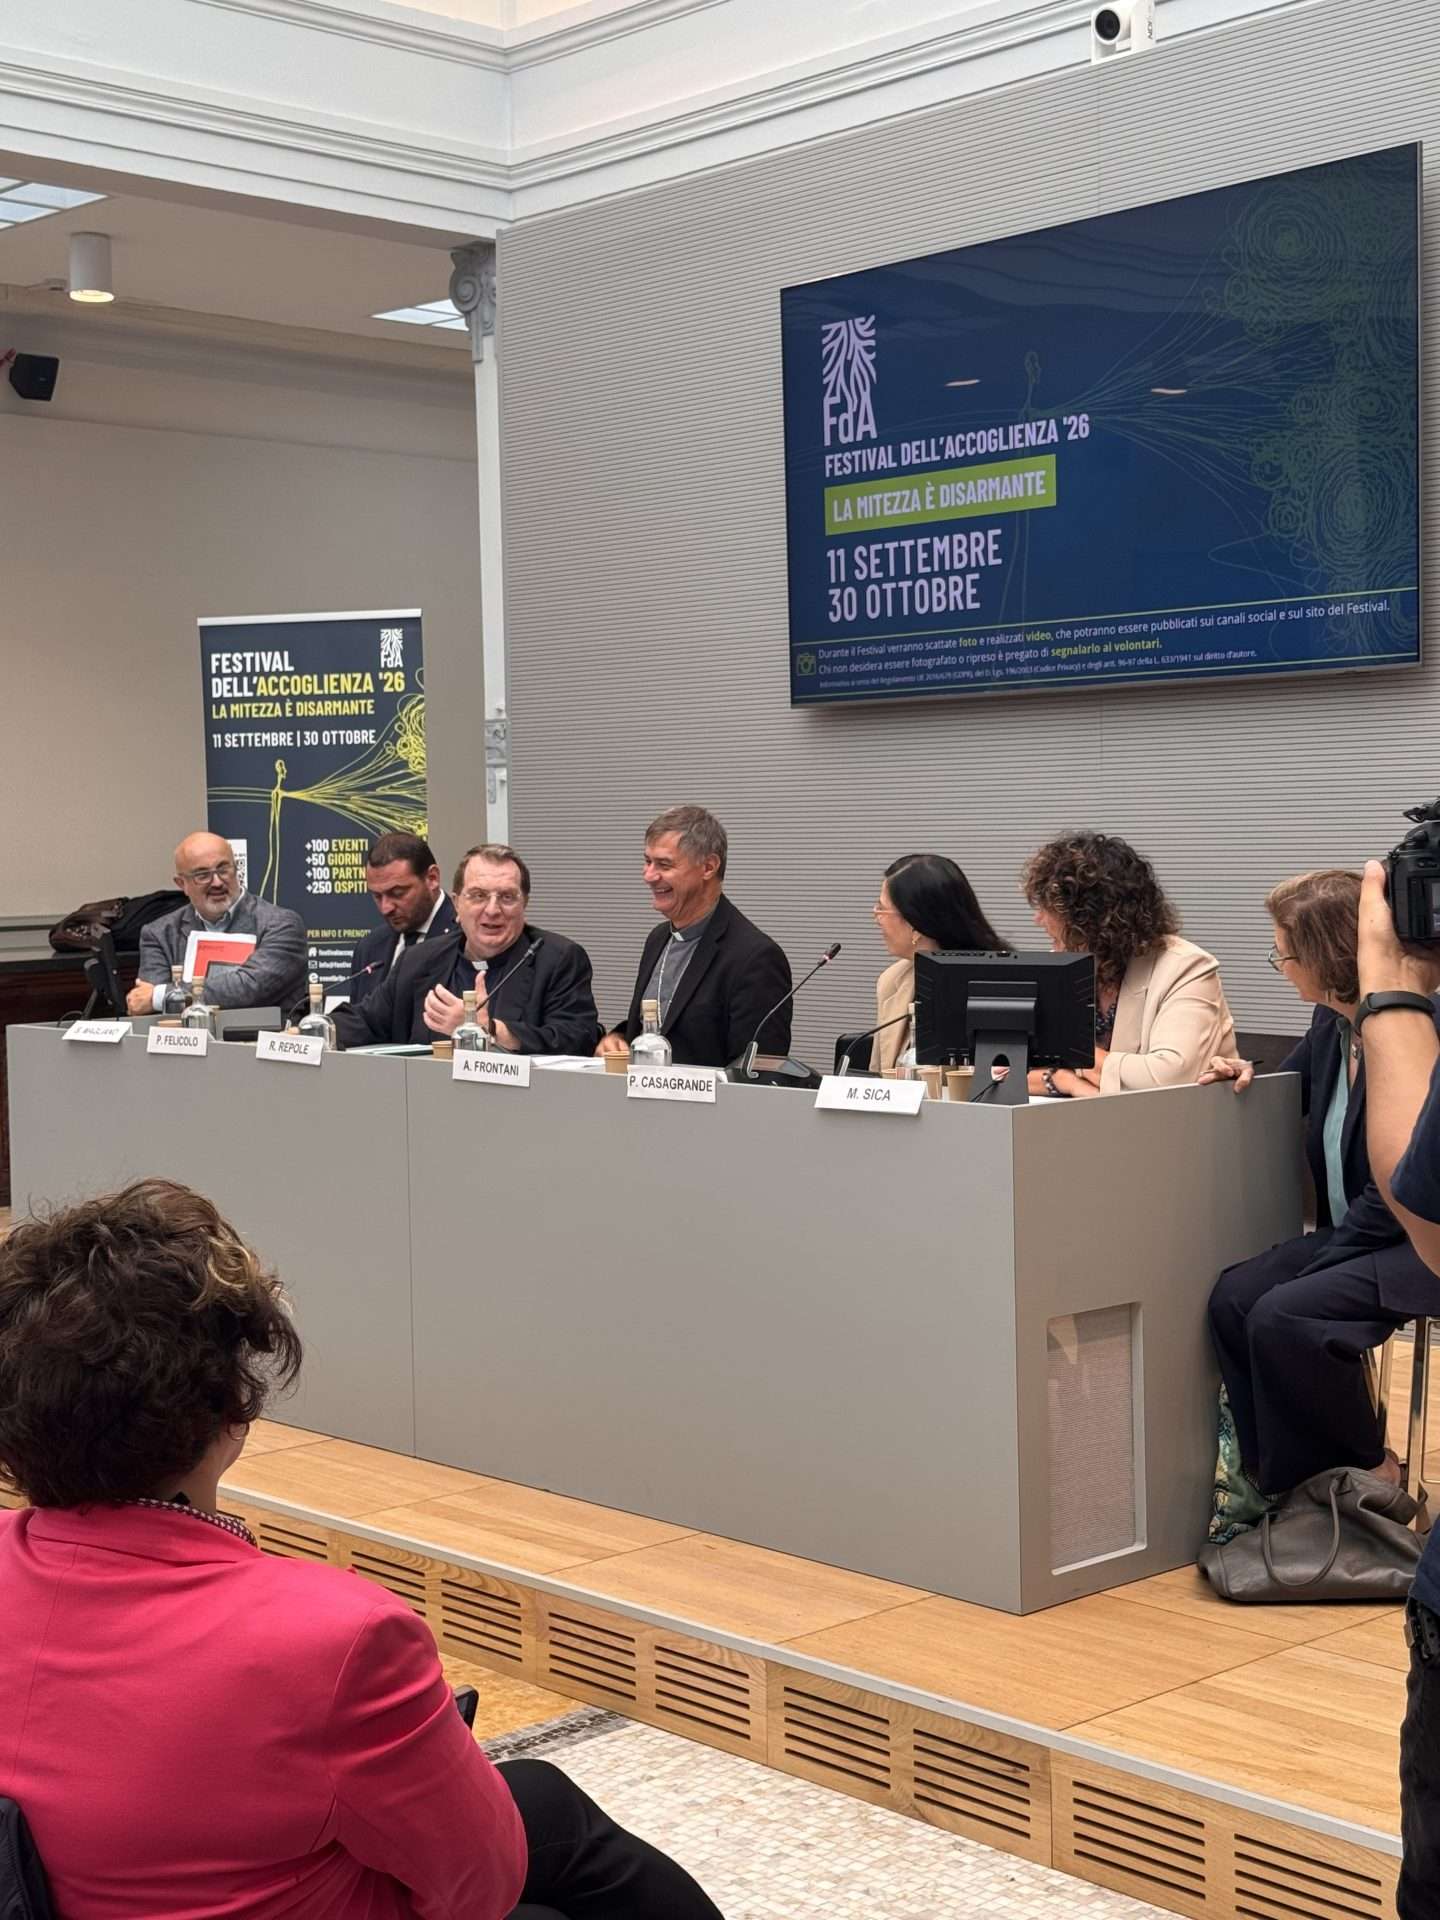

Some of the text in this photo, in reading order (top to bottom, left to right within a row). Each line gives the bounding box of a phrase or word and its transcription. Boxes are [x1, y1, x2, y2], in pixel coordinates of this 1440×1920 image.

[825, 414, 1089, 477] FESTIVAL DELL'ACCOGLIENZA '26
[834, 470, 1046, 522] LA MITEZZA È DISARMANTE
[827, 529, 1002, 584] 11 SETTEMBRE
[828, 573, 980, 623] 30 OTTOBRE
[818, 646, 848, 659] Durante
[856, 643, 885, 656] Festival
[886, 642, 923, 653] verranno
[925, 638, 957, 650] scattate
[959, 635, 976, 647] foto
[979, 637, 984, 645] e
[986, 631, 1023, 645] realizzati
[1025, 628, 1053, 642] video,
[1055, 627, 1071, 639] che
[1074, 624, 1115, 640] potranno
[1118, 622, 1148, 634] essere
[1150, 615, 1196, 634] pubblicati
[1216, 611, 1244, 625] canali
[1247, 608, 1276, 622] social
[1279, 610, 1285, 620] e
[1287, 606, 1303, 619] sul
[1305, 604, 1324, 617] sito
[1327, 602, 1343, 615] del
[1346, 598, 1389, 614] Festival.
[211, 651, 294, 674] FESTIVAL
[818, 663, 830, 674] Chi
[832, 664, 847, 673] non
[849, 659, 882, 672] desidera
[883, 659, 909, 669] essere
[911, 653, 957, 670] fotografato
[958, 655, 964, 663] o
[966, 649, 995, 665] ripreso
[1005, 648, 1038, 663] pregato
[1040, 646, 1048, 657] di
[1050, 642, 1100, 659] segnalarlo
[1114, 636, 1162, 651] volontari.
[212, 671, 405, 698] DELL'ACCOGLIENZA '26
[212, 698, 375, 719] LA MITEZZA È DISARMANTE
[213, 734, 221, 748] 11
[225, 732, 293, 748] SETTEMBRE
[304, 731, 318, 746] 30
[323, 730, 376, 745] OTTOBRE
[305, 838, 369, 852] +100 EVENTI
[305, 853, 362, 866] +50 GIORNI
[305, 866, 367, 880] +100 PARTN
[306, 880, 368, 894] +250 OSPITI
[343, 928, 371, 937] PRENOT
[156, 1034, 199, 1047] P. FELICOLO
[279, 1041, 310, 1055] REPOLE
[463, 1060, 519, 1076] A. FRONTANI
[629, 1075, 713, 1092] P. CASAGRANDE
[846, 1087, 891, 1101] M. SICA
